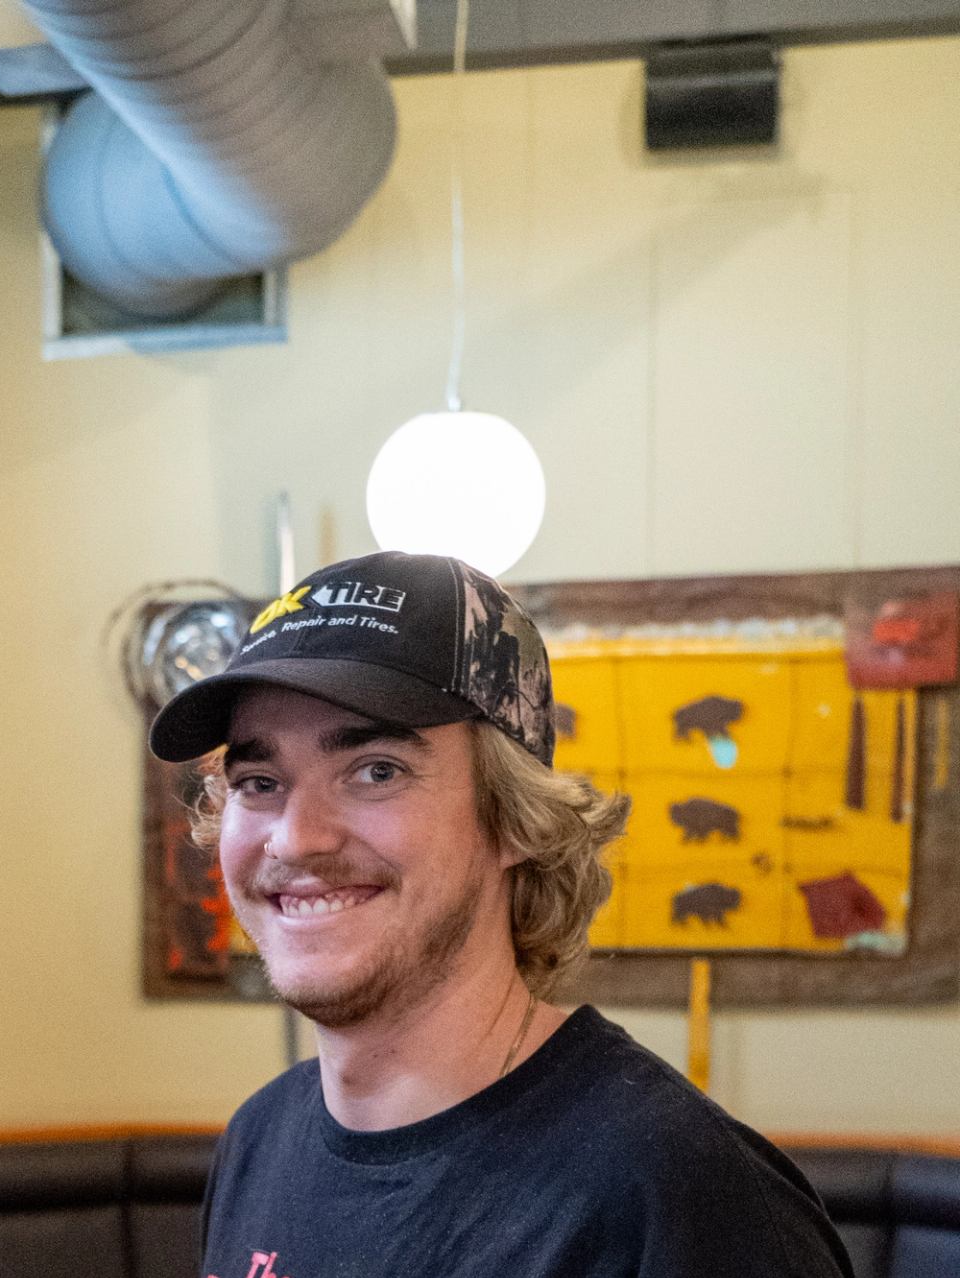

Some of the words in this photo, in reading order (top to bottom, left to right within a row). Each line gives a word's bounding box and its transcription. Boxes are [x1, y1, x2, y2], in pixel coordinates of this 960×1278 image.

[326, 581, 406, 613] TIRE
[281, 615, 326, 632] Repair
[328, 615, 357, 626] and
